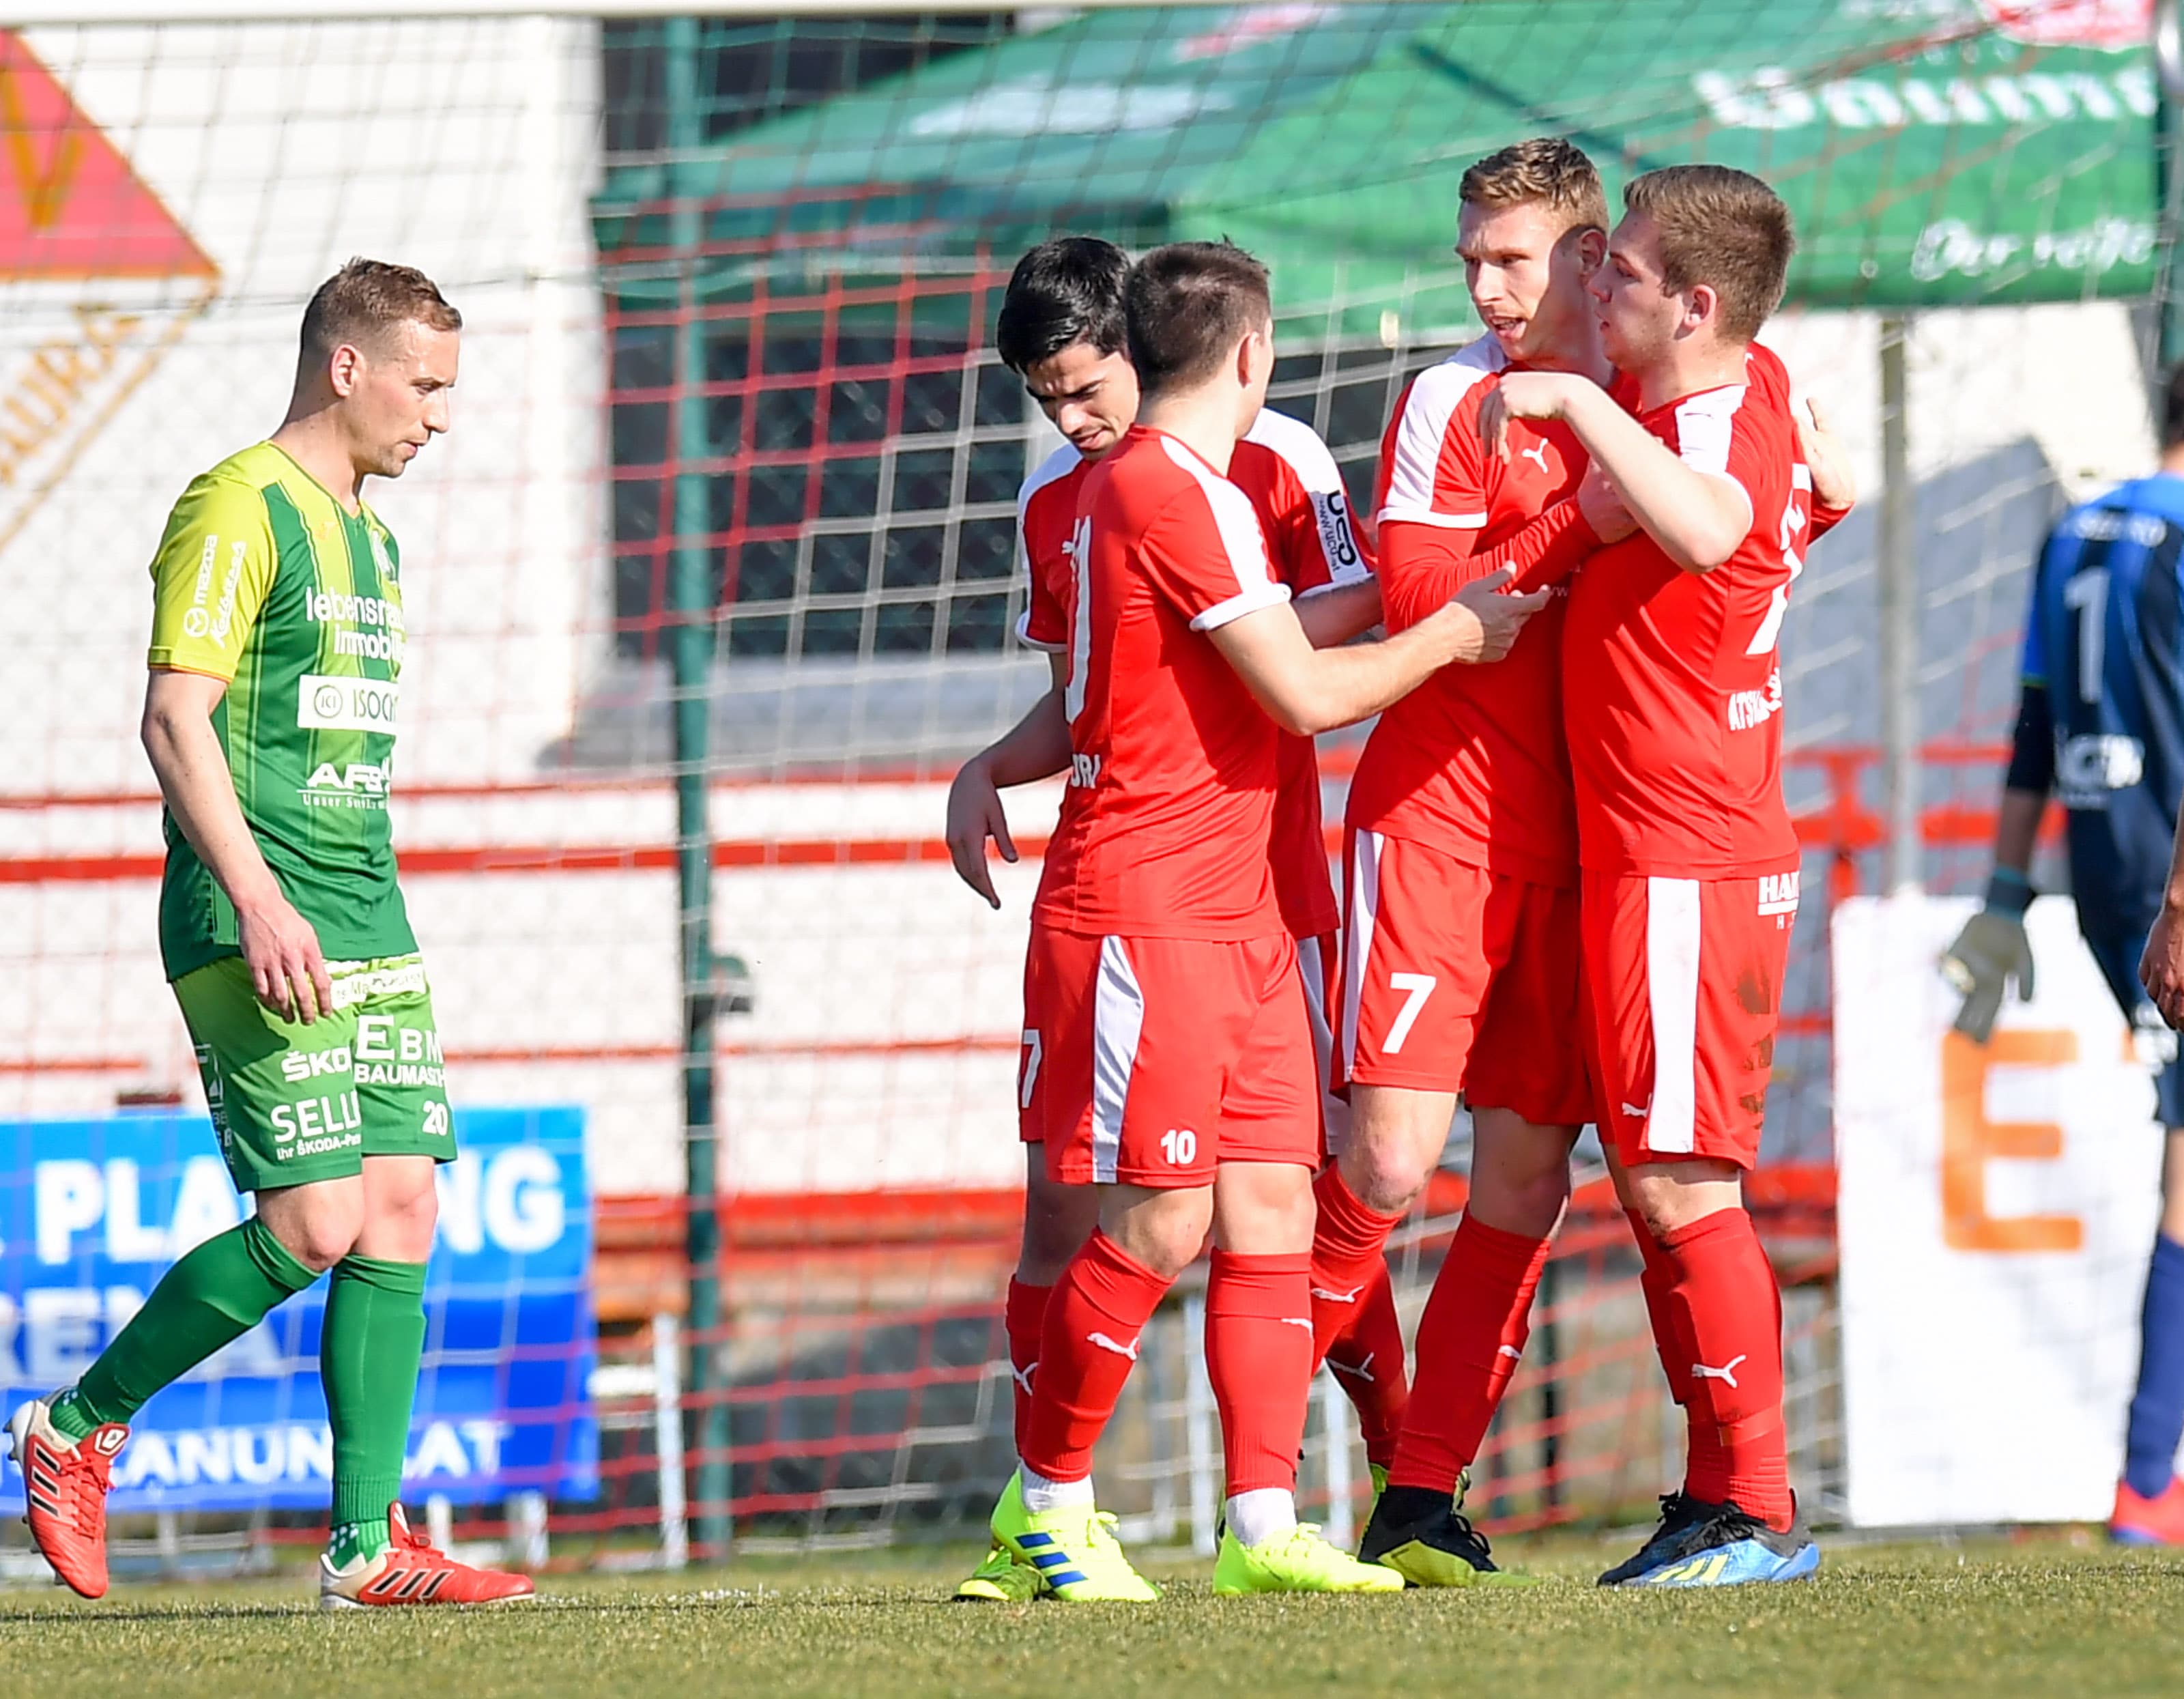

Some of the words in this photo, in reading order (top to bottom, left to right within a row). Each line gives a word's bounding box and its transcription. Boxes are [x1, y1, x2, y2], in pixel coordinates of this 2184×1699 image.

[2064, 566, 2110, 704] 1
[1381, 972, 1437, 1054] 7
[422, 1100, 448, 1136] 20
[1160, 1129, 1196, 1165] 10
[1941, 1028, 2138, 1252] E
